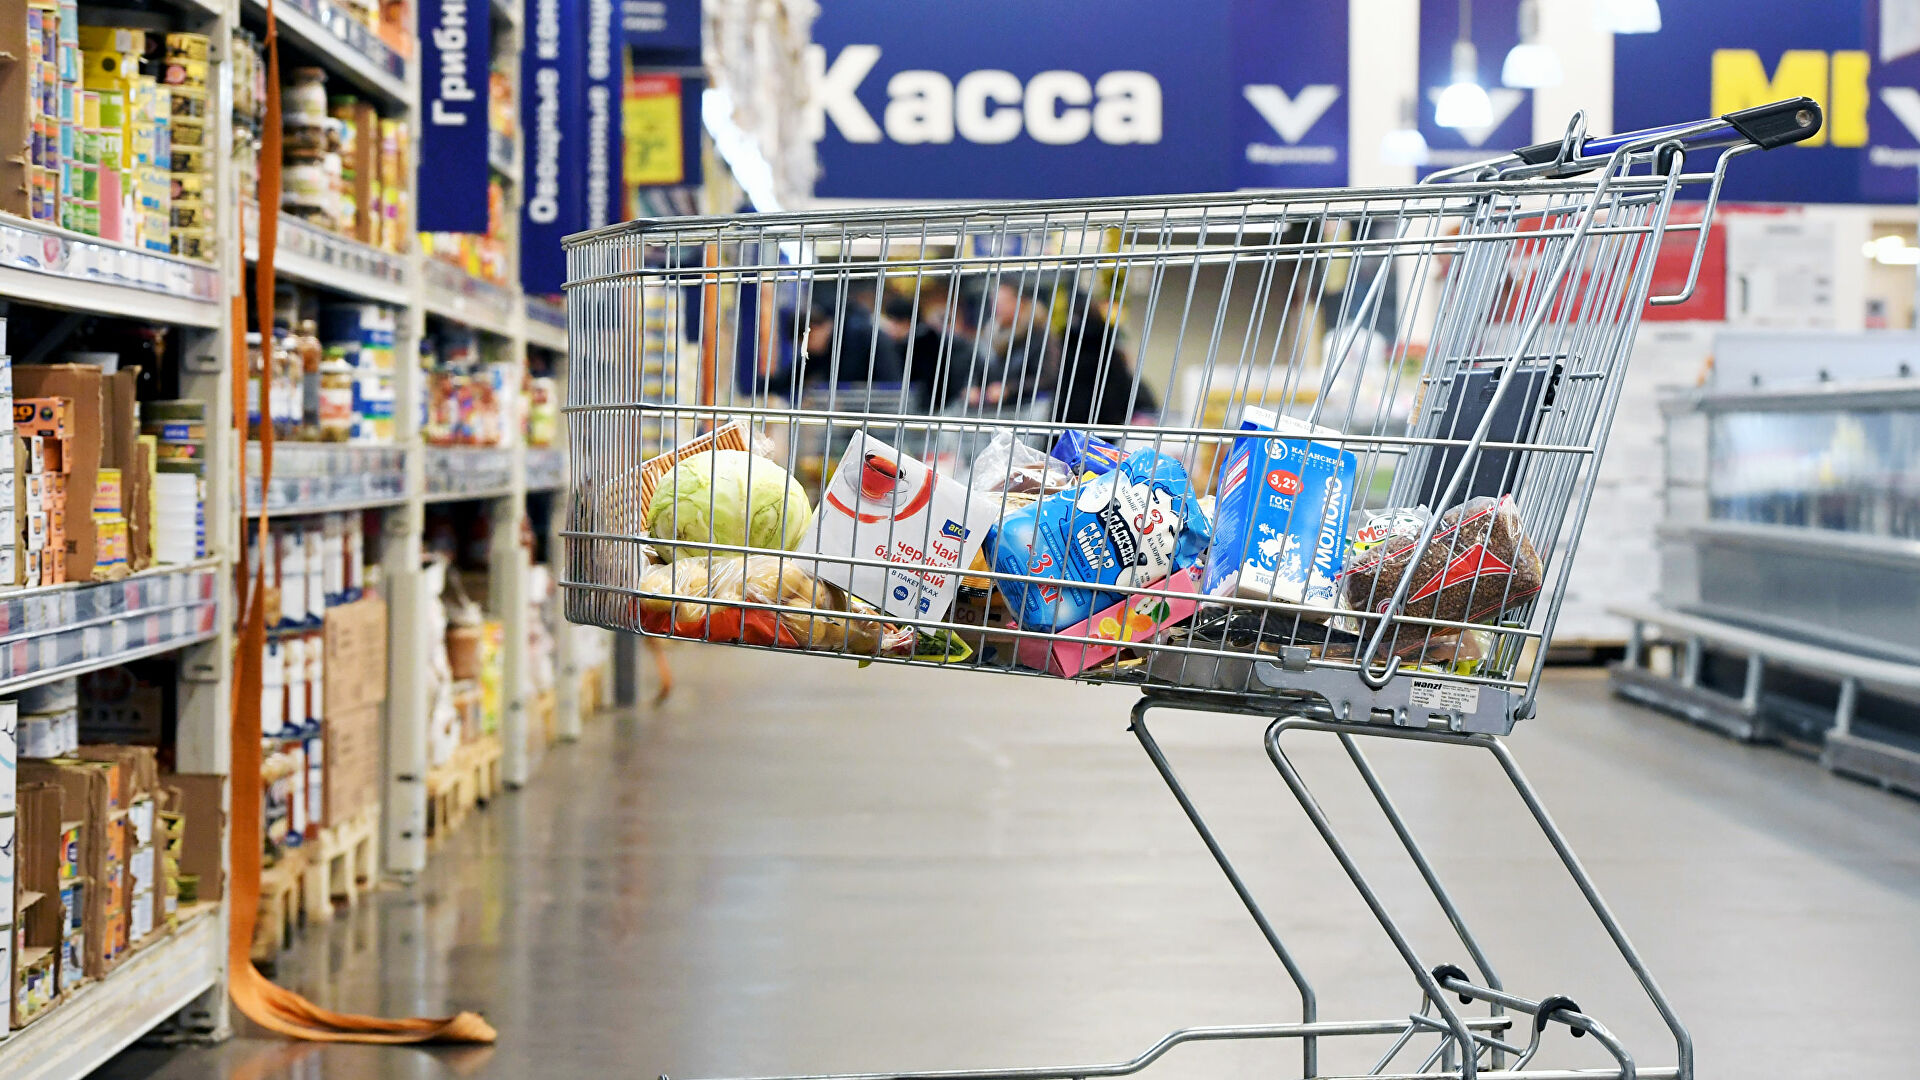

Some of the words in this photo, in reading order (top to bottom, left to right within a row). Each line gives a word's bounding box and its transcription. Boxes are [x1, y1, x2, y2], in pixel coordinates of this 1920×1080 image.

[535, 0, 561, 60] кон
[587, 0, 614, 81] овощ
[431, 0, 477, 126] Грибн
[808, 43, 1164, 146] Касса
[528, 67, 563, 224] Овощные
[1270, 473, 1301, 492] 3,2%
[1076, 522, 1115, 570] САХАР
[1099, 507, 1137, 566] СЛАДКИЙ
[1133, 508, 1164, 535] 3
[1315, 476, 1342, 570] МОЛОКО
[932, 540, 959, 564] Чай
[1413, 680, 1443, 690] wanzl
